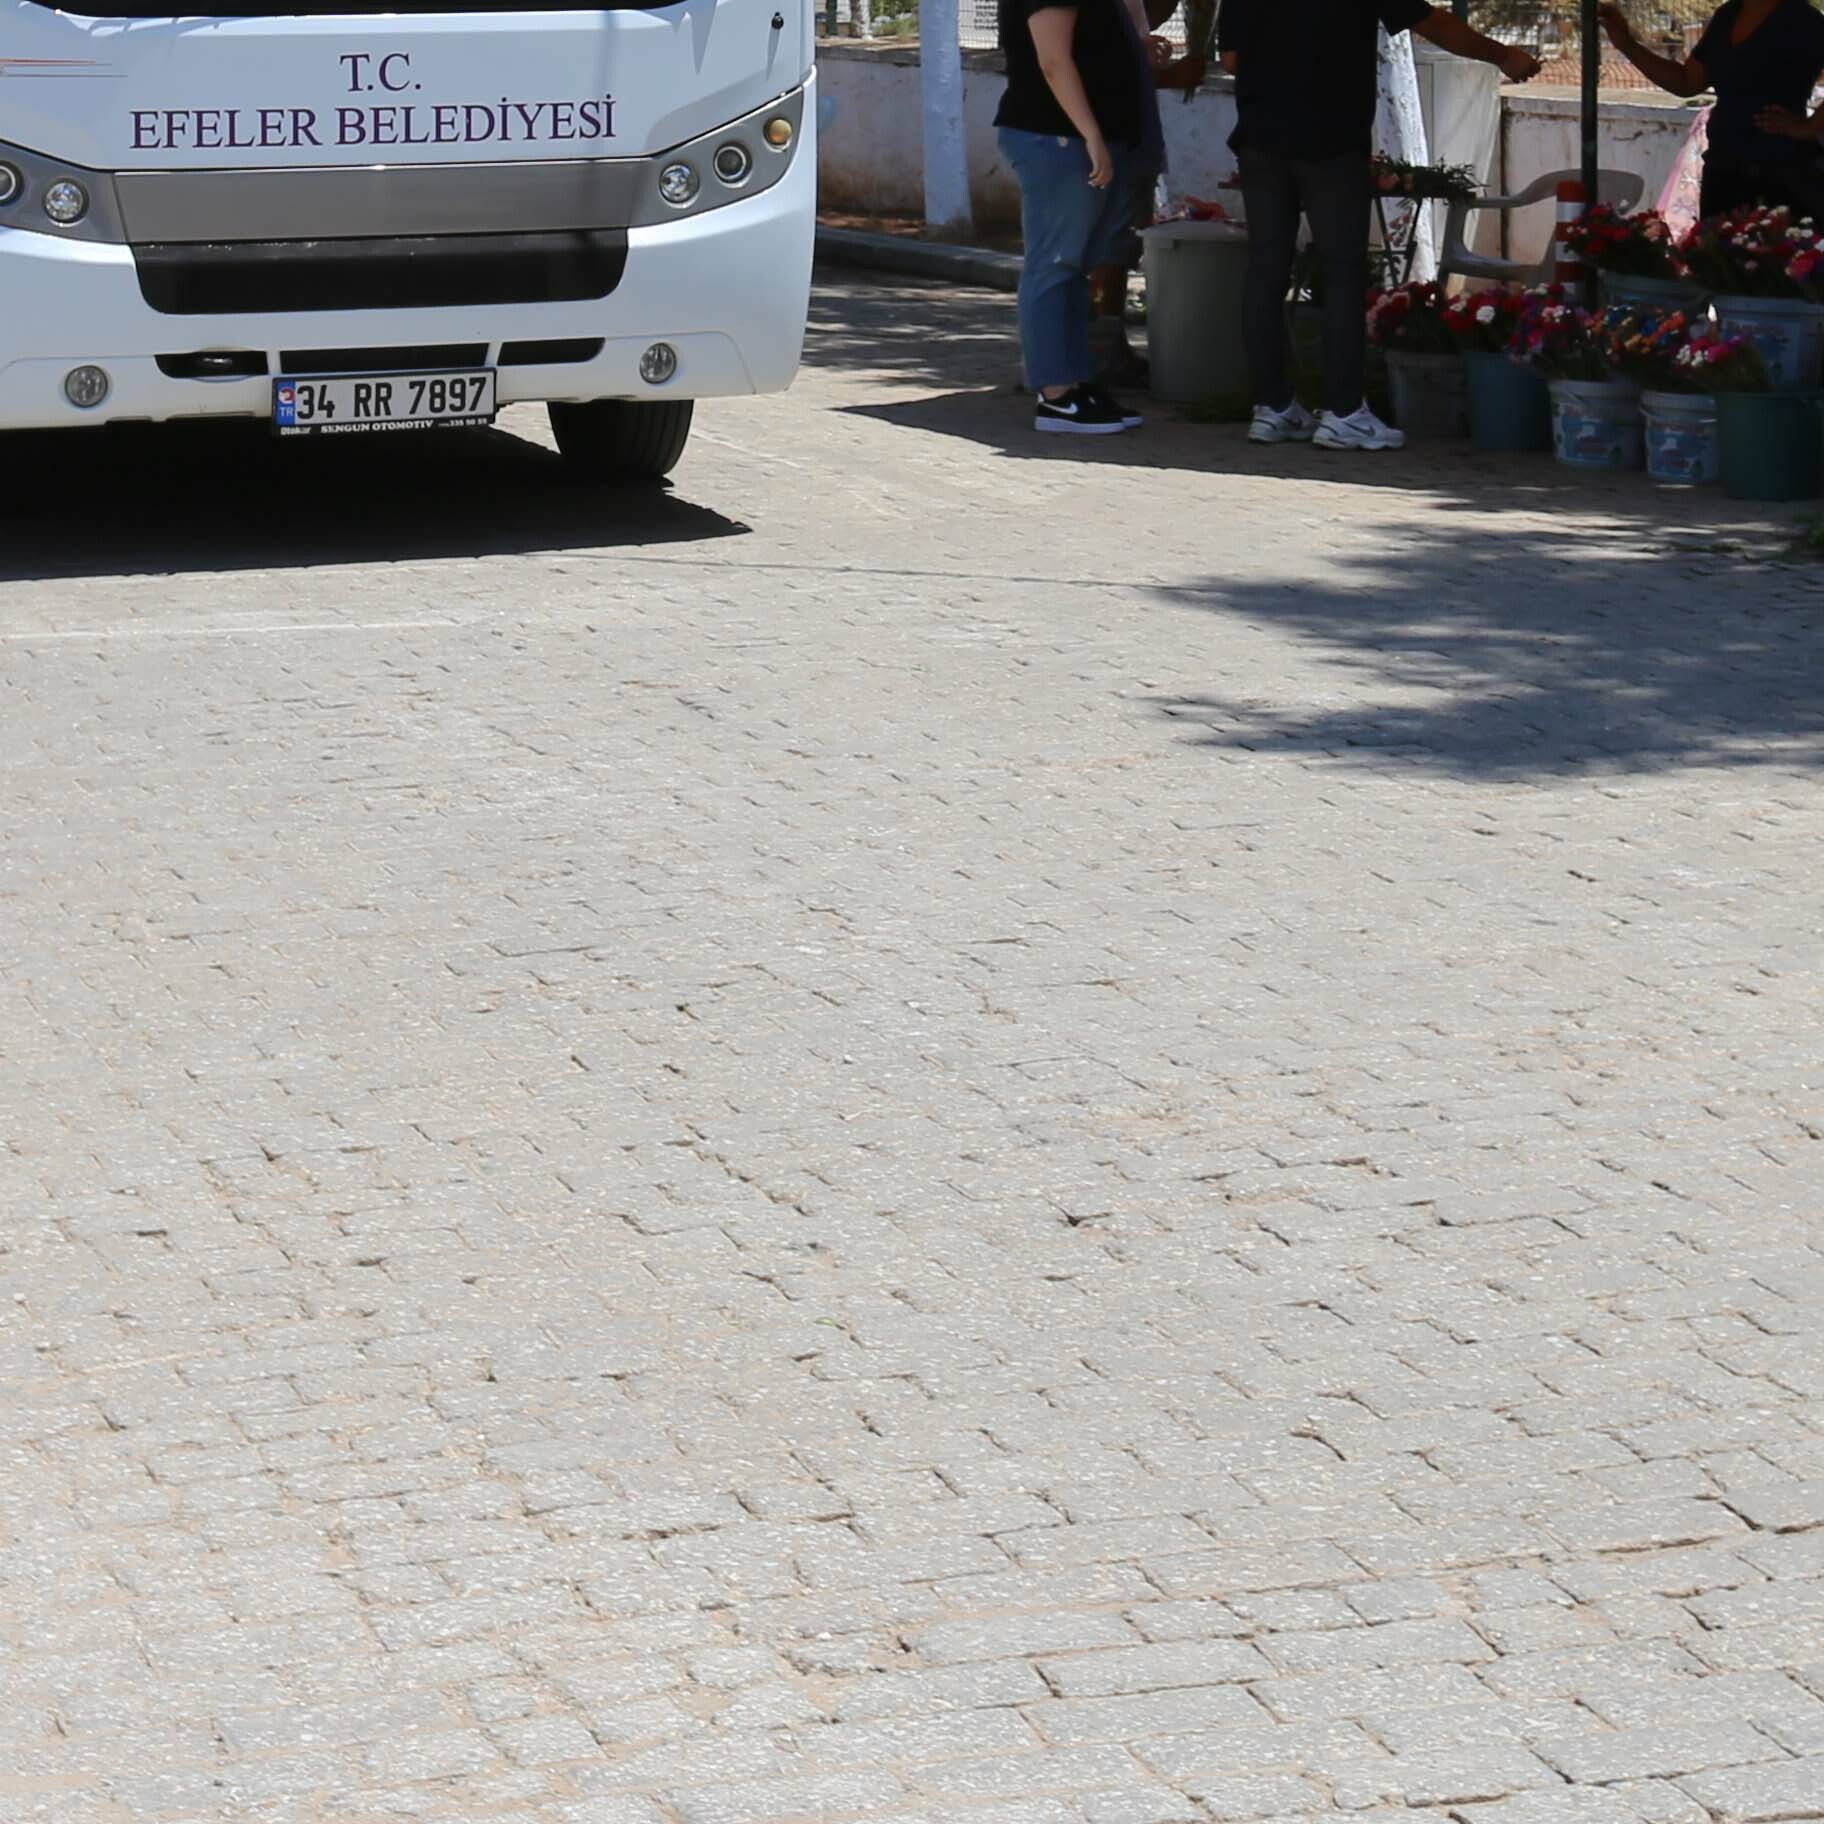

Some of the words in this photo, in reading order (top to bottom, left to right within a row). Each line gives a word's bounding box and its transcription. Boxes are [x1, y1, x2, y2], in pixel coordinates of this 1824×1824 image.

[339, 52, 422, 92] T.C.
[128, 108, 323, 149] EFELER
[334, 93, 617, 147] BELEDİYESİ
[280, 406, 294, 417] TR
[297, 385, 335, 420] 34
[353, 382, 392, 418] RR
[408, 376, 487, 415] 7897
